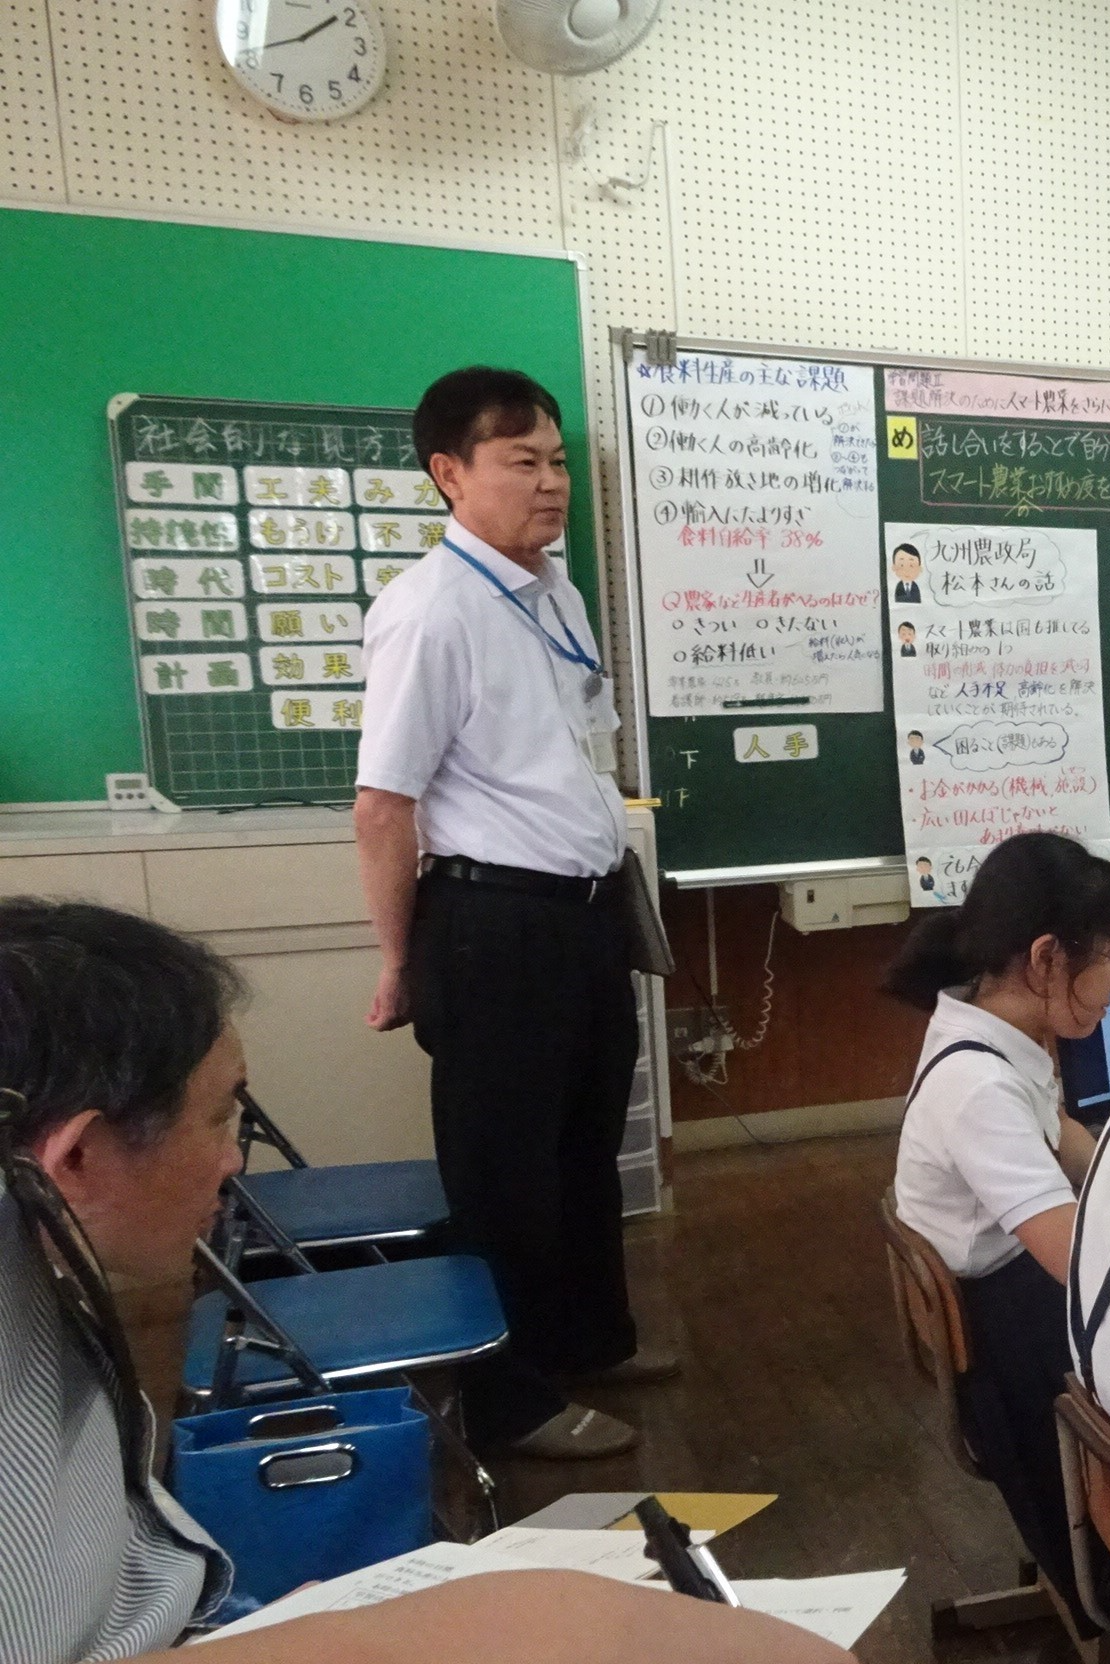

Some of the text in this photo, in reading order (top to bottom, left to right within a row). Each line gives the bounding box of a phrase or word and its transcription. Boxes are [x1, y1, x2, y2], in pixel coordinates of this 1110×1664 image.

[344, 7, 357, 27] 2
[354, 36, 367, 56] 3
[270, 72, 284, 93] 7
[347, 64, 361, 83] 4
[299, 84, 314, 104] 6
[328, 80, 342, 100] 5
[892, 426, 914, 449] め
[257, 475, 342, 506] 工夫
[930, 537, 1037, 569] 九州農政局
[144, 566, 235, 597] 時代
[264, 563, 343, 590] コスト
[942, 570, 1056, 597] 松本さんの話
[146, 608, 236, 638] 時間
[269, 609, 349, 638] 願い
[272, 652, 354, 681] 効果
[743, 731, 809, 760] 人手
